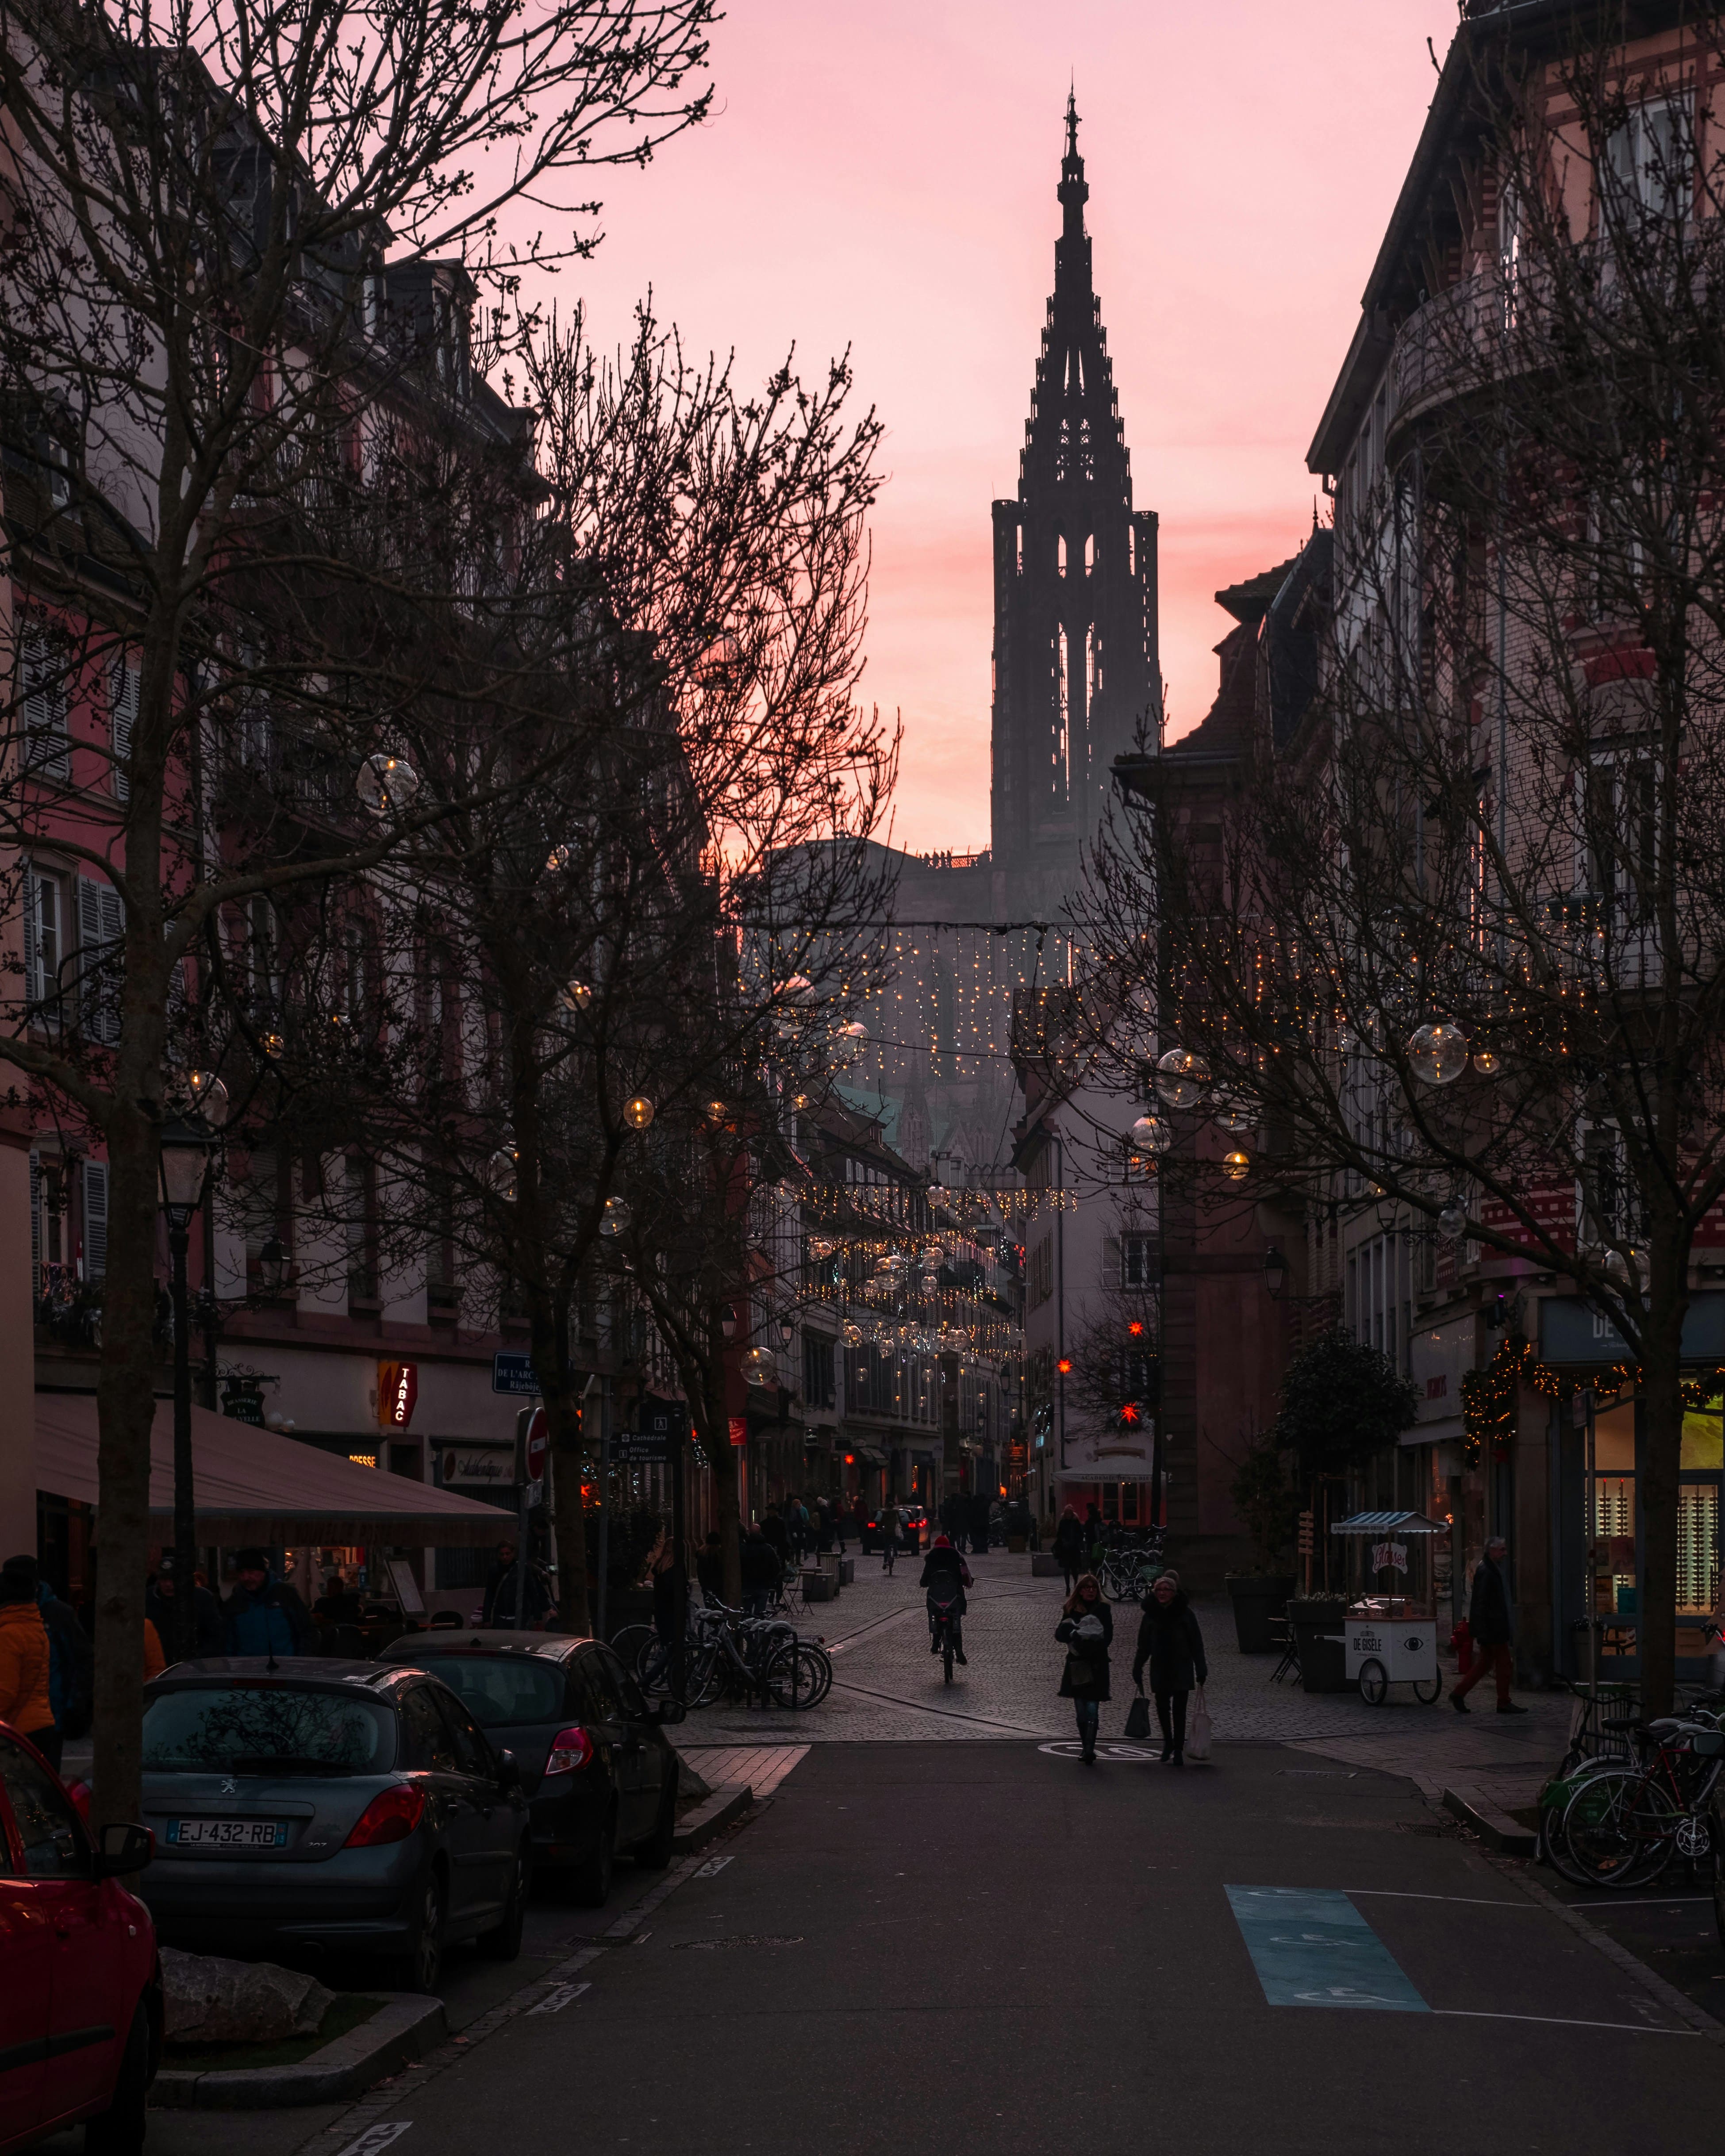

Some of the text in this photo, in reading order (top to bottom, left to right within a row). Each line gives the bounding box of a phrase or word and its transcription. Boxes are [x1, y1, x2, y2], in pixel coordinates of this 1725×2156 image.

[498, 1369, 534, 1379] DE L'ARC
[396, 1368, 409, 1420] TABAC
[227, 1398, 257, 1406] BRASSERIE
[1353, 1638, 1361, 1650] DE
[179, 1823, 275, 1843] EJ-432-RB
